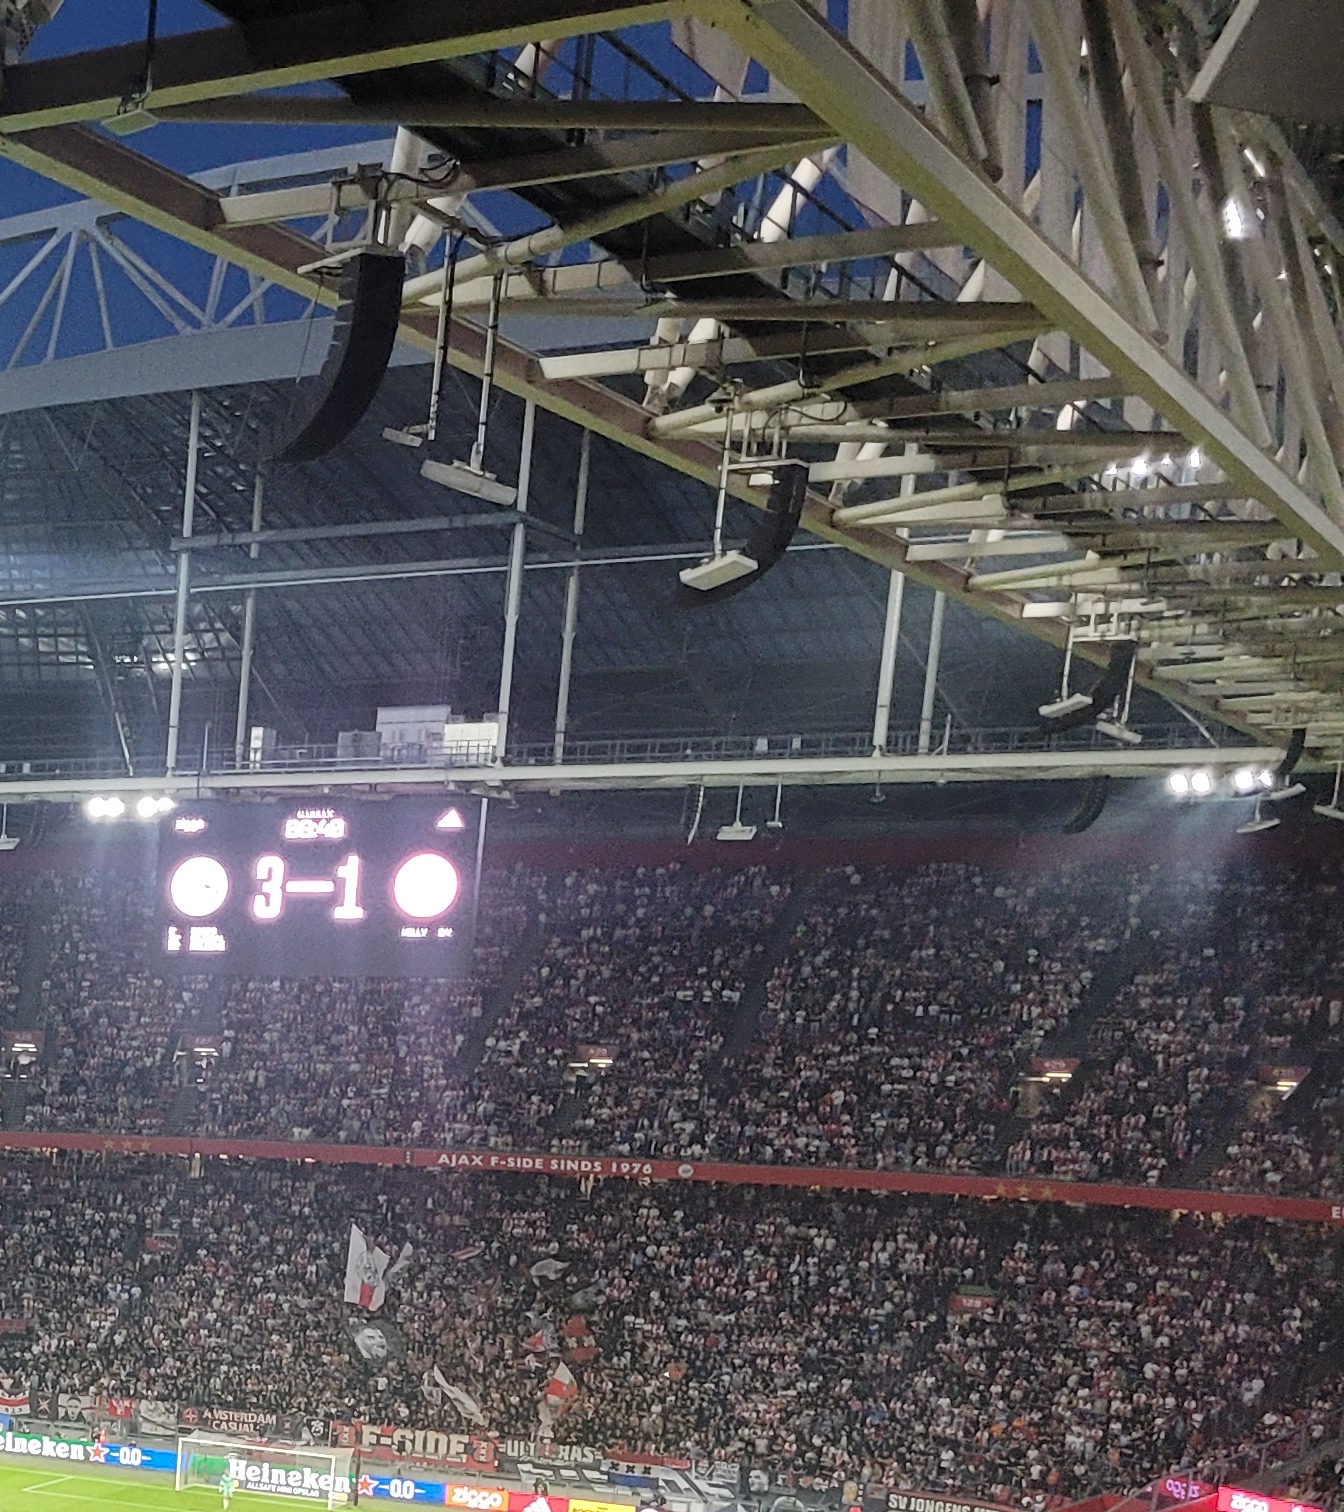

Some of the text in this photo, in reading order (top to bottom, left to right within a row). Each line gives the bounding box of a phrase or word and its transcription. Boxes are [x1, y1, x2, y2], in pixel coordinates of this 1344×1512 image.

[438, 1153, 653, 1175] AJAX F-SIDE SINDS 1976
[203, 1408, 277, 1426] AMSTERDAM
[229, 1458, 352, 1493] Heineken
[451, 1486, 502, 1509] ziggo
